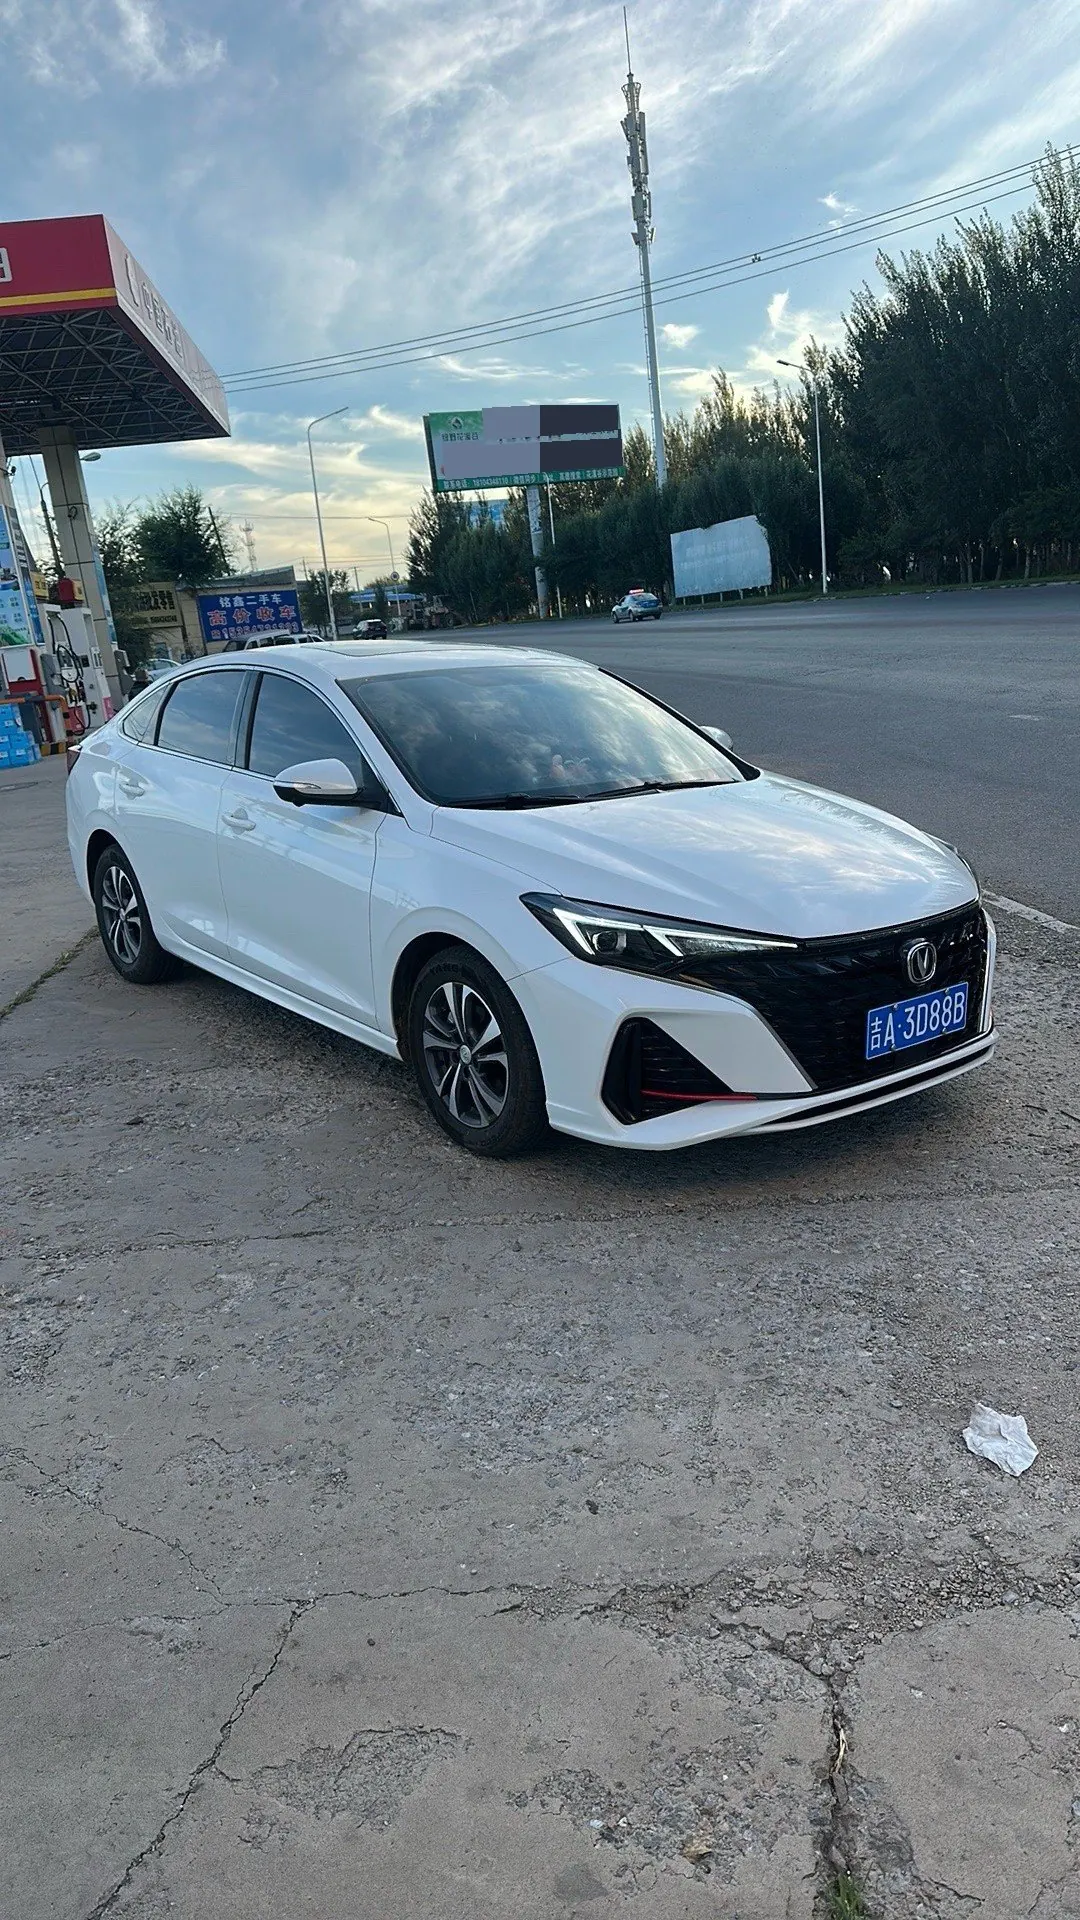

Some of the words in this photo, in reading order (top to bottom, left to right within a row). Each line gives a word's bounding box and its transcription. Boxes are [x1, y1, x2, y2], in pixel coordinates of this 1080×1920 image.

[219, 594, 282, 608] 铭鑫二手车
[207, 605, 296, 626] 高价收车
[870, 991, 965, 1051] 吉A·3D88B
